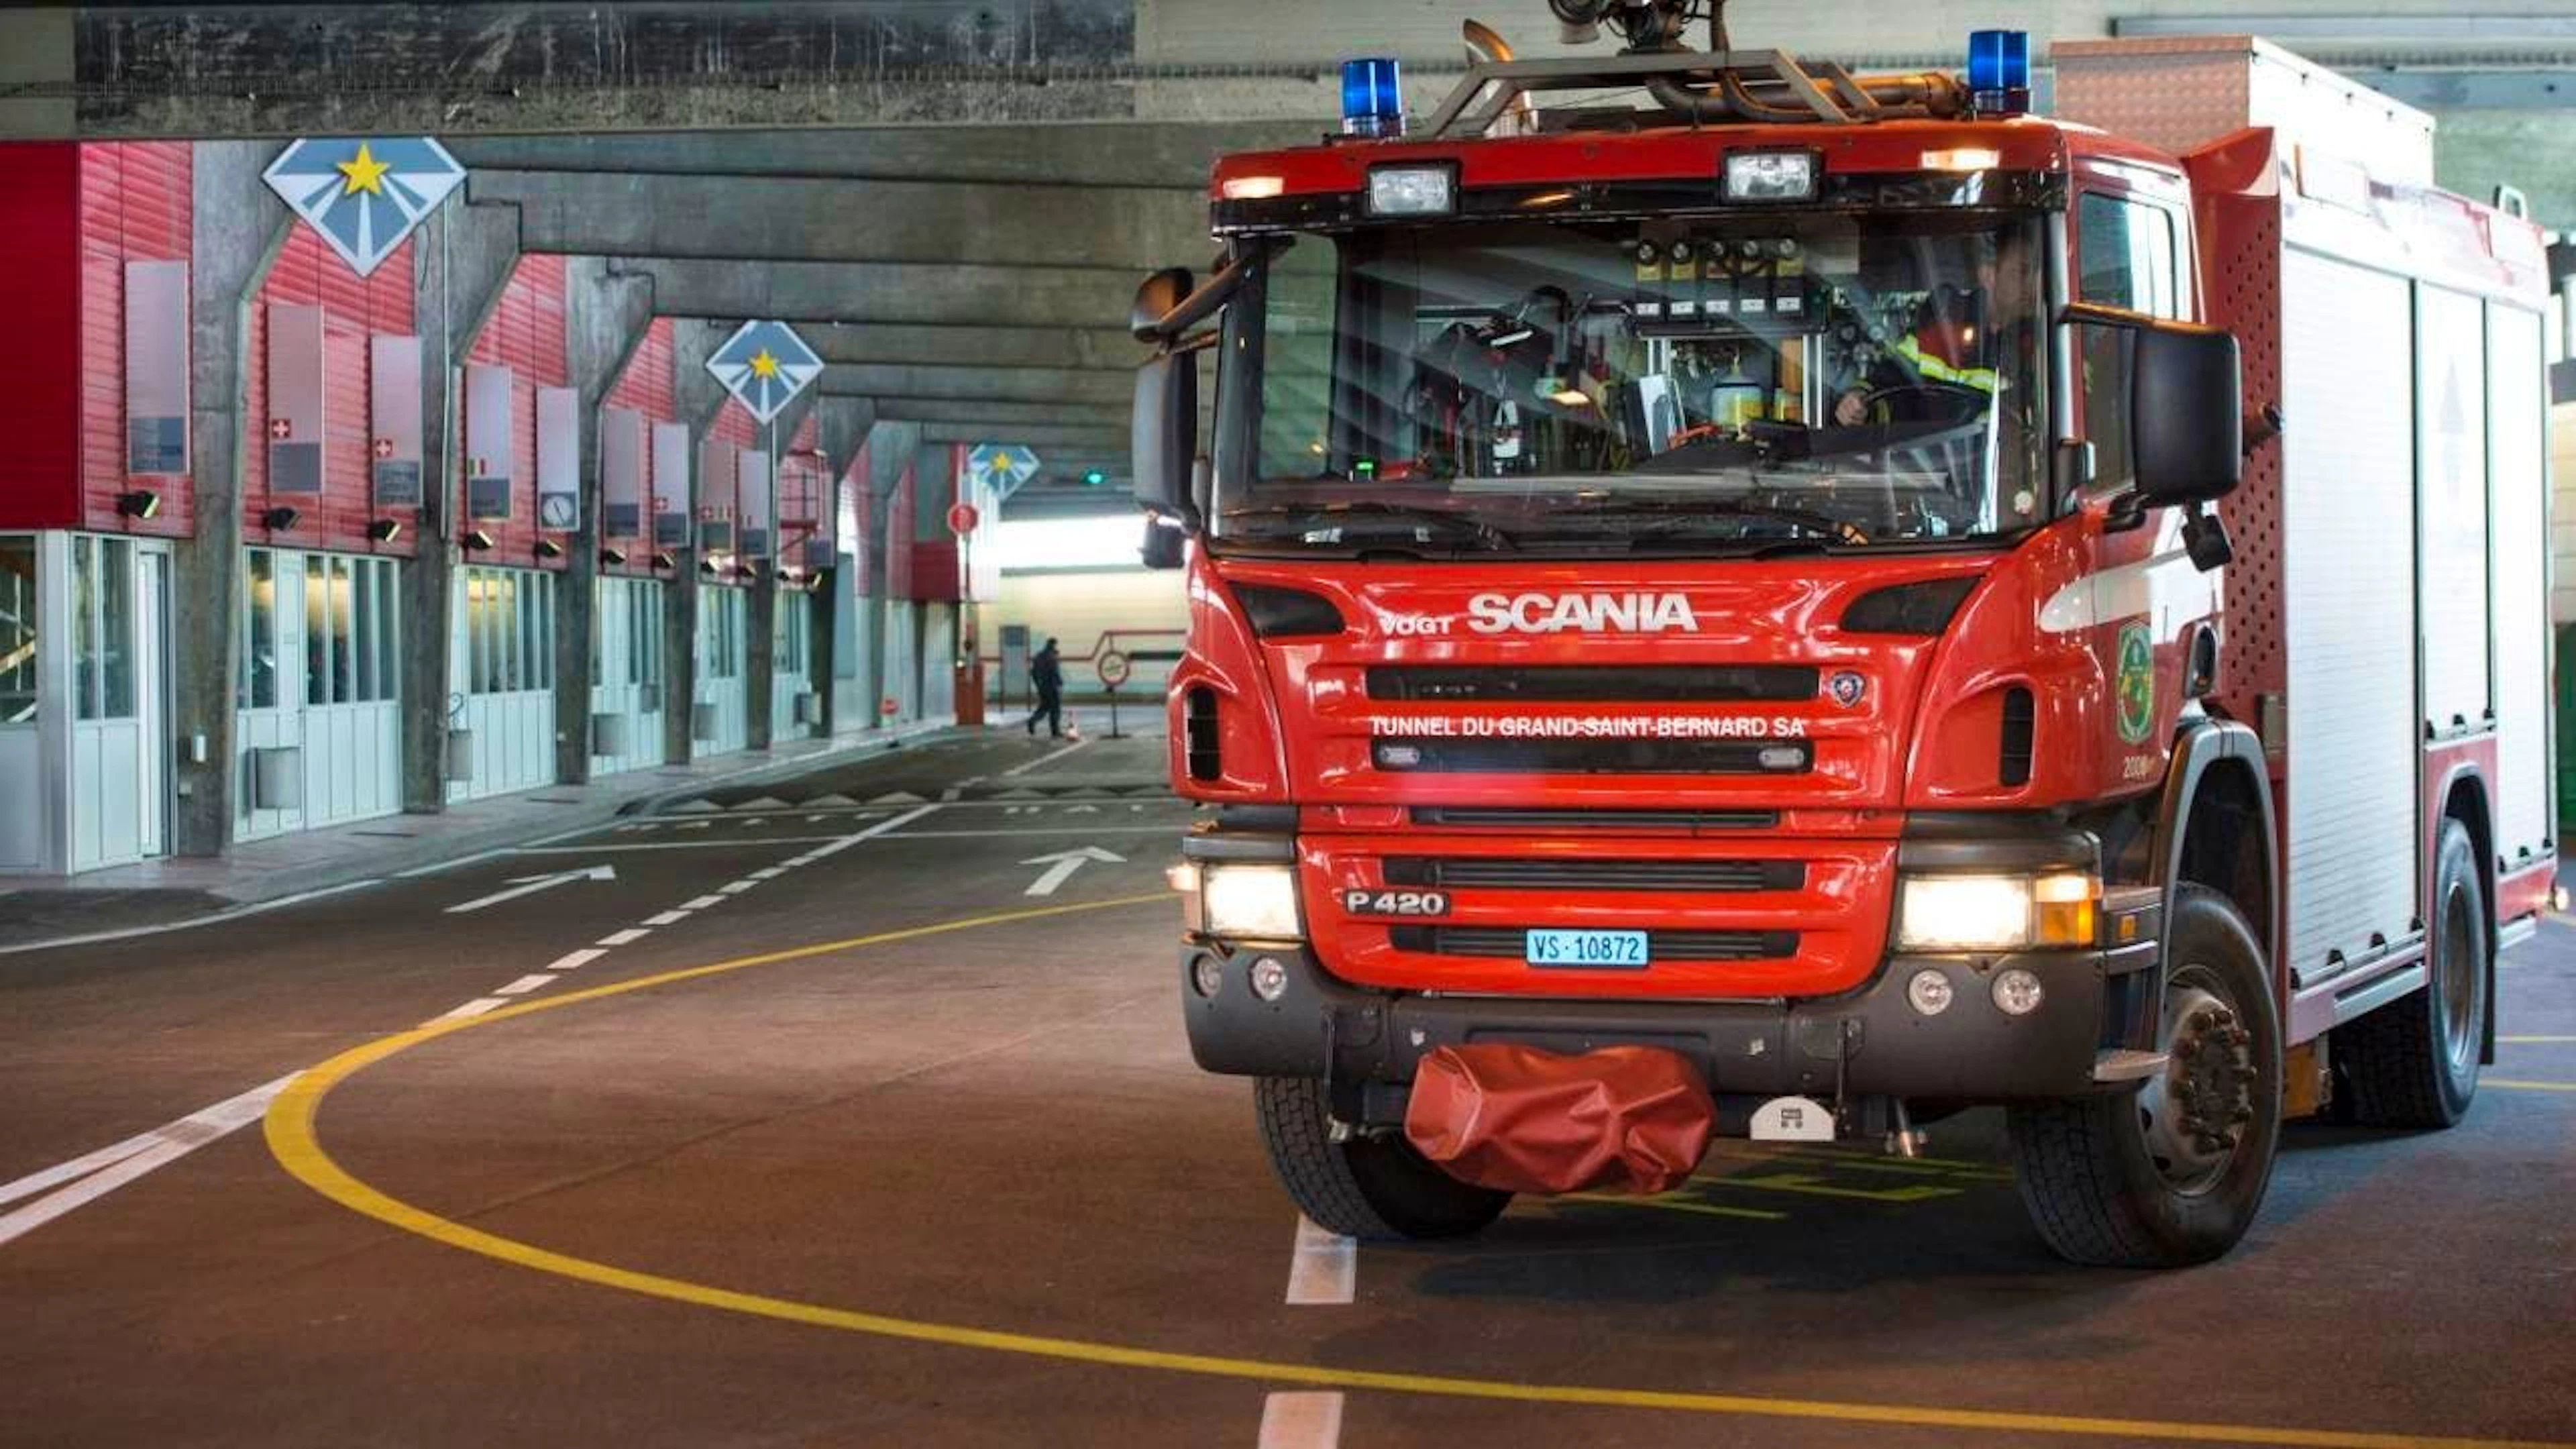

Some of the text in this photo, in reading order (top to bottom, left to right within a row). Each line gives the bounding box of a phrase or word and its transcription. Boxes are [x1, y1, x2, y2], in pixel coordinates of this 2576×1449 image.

[1379, 613, 1454, 635] VOGT
[1466, 592, 1699, 633] SCANIA
[1370, 716, 1457, 736] TUNNEL
[1462, 716, 1494, 736] DU
[1773, 716, 1805, 737] SA
[1347, 891, 1444, 915] P 420
